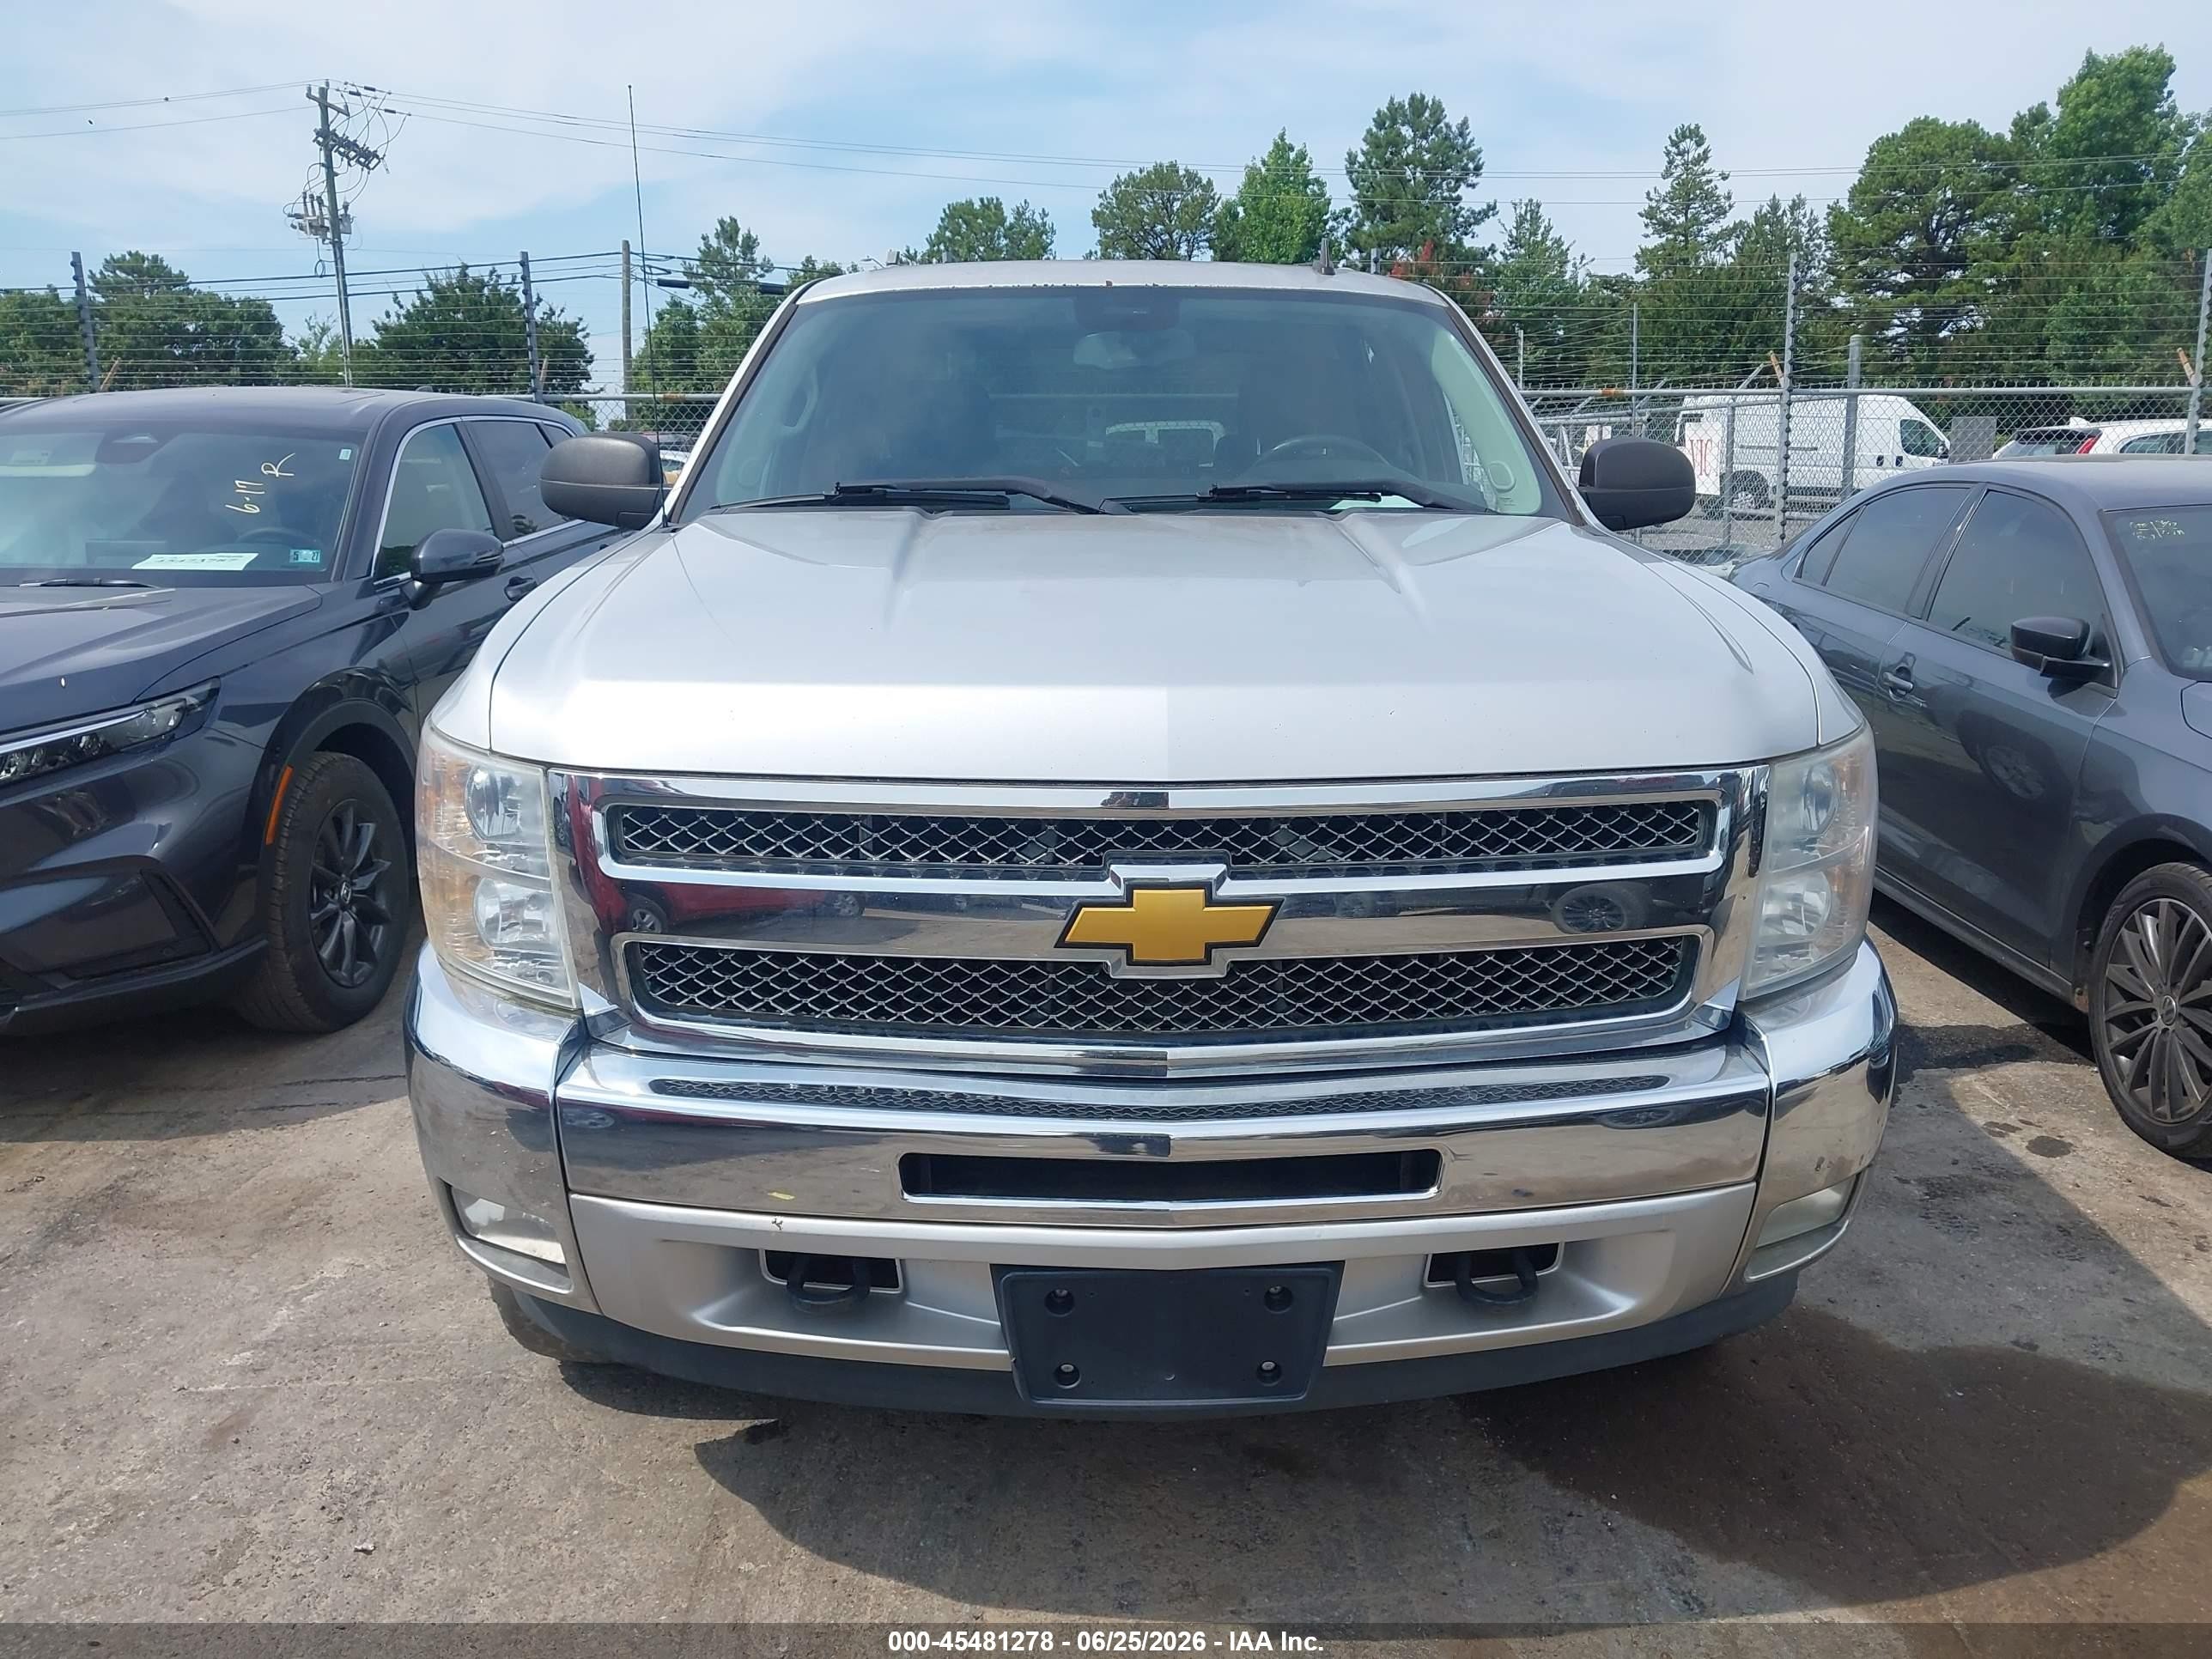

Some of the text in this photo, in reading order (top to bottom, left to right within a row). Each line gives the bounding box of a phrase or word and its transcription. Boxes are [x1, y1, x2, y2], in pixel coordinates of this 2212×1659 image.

[260, 453, 295, 477] R
[293, 550, 319, 562] 5 27
